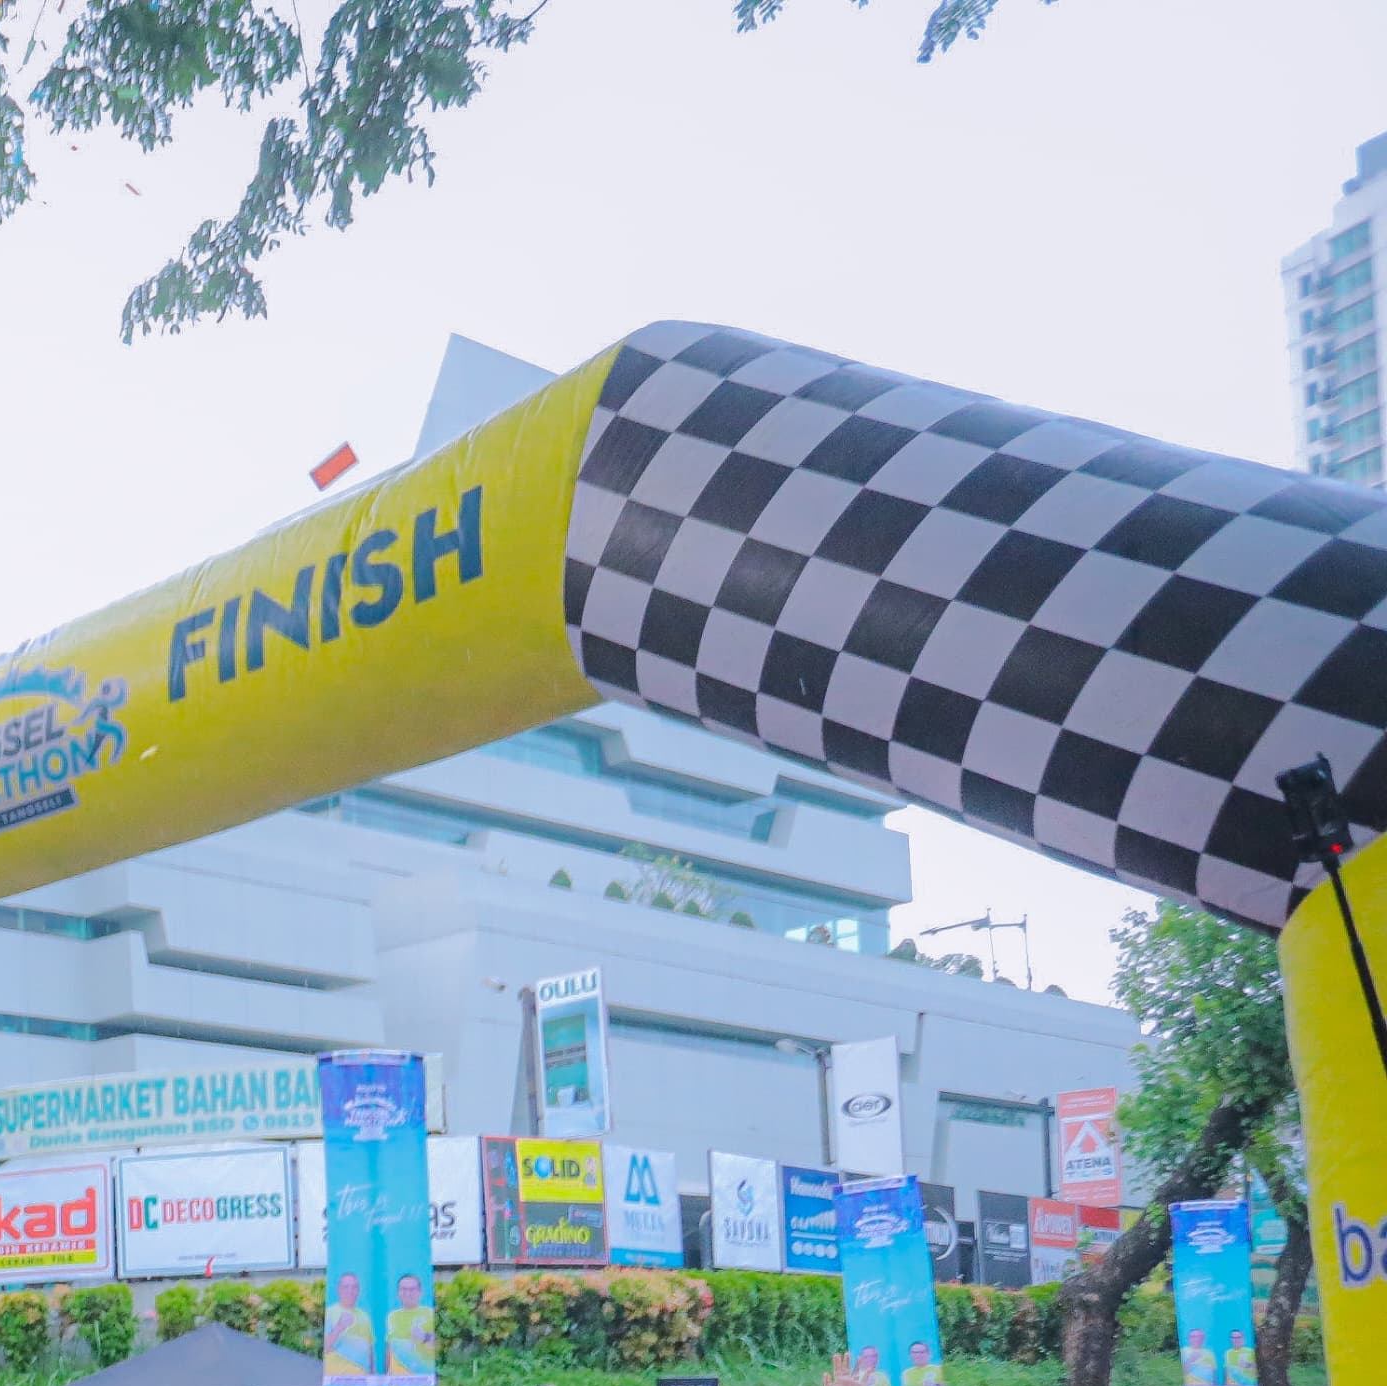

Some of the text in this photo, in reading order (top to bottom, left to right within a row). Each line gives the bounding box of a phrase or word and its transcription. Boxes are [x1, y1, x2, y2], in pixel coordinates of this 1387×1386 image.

[167, 484, 484, 703] FINISH
[172, 1069, 271, 1116] BAHAN
[521, 1154, 582, 1180] SOLID
[1065, 1155, 1112, 1172] ATENA
[162, 1192, 283, 1224] DECOGRESS
